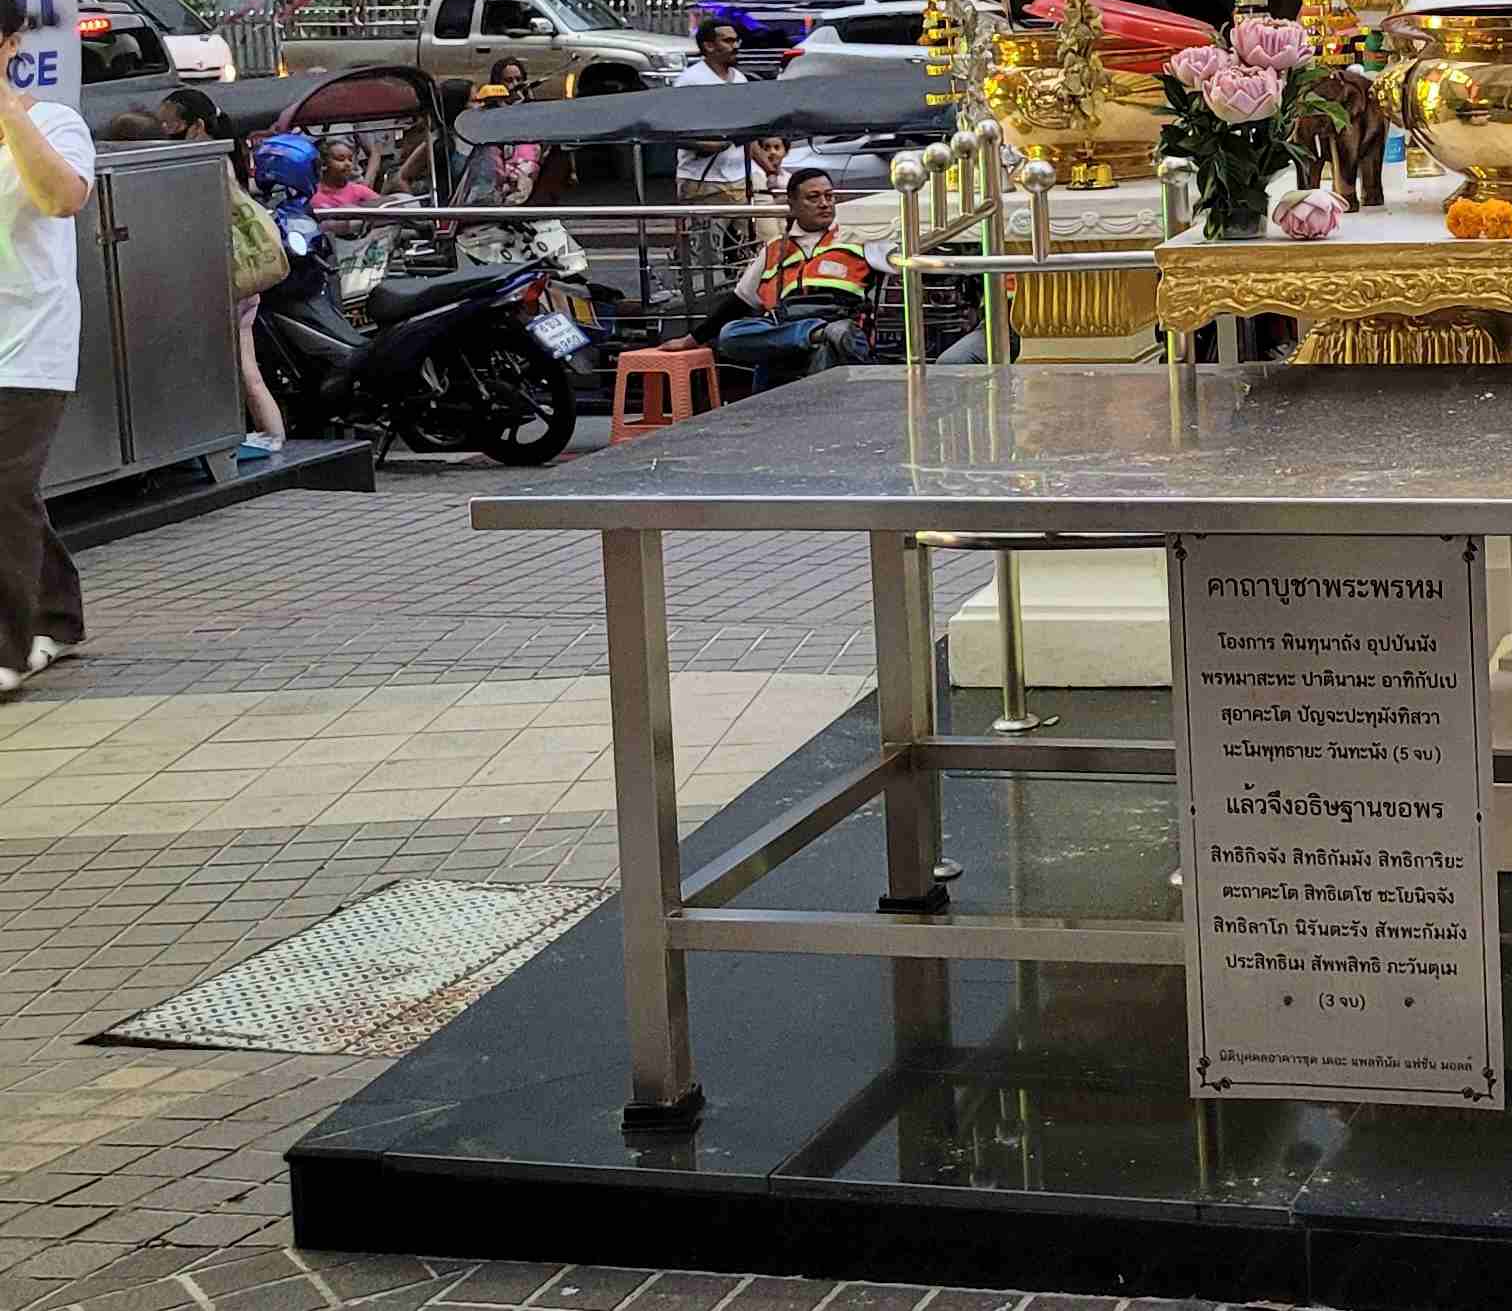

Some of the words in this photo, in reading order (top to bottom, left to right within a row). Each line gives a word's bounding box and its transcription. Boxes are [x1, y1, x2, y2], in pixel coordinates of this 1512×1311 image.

[1207, 577, 1443, 605] คาถาบูชาพระพรหม
[1218, 631, 1275, 651] โองการ
[1281, 632, 1361, 656] พินทุนาถัง
[1367, 634, 1437, 656] อุปปันนัง
[1302, 668, 1376, 687] ปาตินามะ
[1382, 670, 1457, 689] อาทิกัปเป
[1221, 705, 1291, 726] สุอาคะโต
[1297, 704, 1440, 729] ปัญจะปะทุมังทิสวา
[1223, 740, 1322, 763] นะโมพุทธายะ
[1327, 742, 1388, 760] วันทะนัง
[1393, 746, 1409, 764] (5
[1414, 746, 1442, 764] จบ)
[1226, 783, 1444, 823] แล้วจึงอธิษฐานขอพร
[1210, 844, 1286, 864] สิทธิกิจจัง
[1293, 847, 1371, 866] สิทธิกัมมัง
[1378, 850, 1464, 869] สิทธิการิยะ
[1222, 883, 1299, 901] ตะถาคะโต
[1304, 884, 1372, 902] สิทธิเตโช
[1378, 885, 1455, 905] ชะโยนิจจัง
[1213, 916, 1288, 935] สิทธิลาโภ
[1295, 918, 1368, 938] นิรันตะรัง
[1375, 921, 1467, 940] สัพพะกัมมัง
[1226, 952, 1305, 971] ประสิทธิเม
[1311, 954, 1381, 974] สัพพสิทธิ
[1387, 956, 1457, 979] ภะวันตุเม
[1318, 992, 1334, 1010] (3
[1339, 993, 1366, 1010] จบ)
